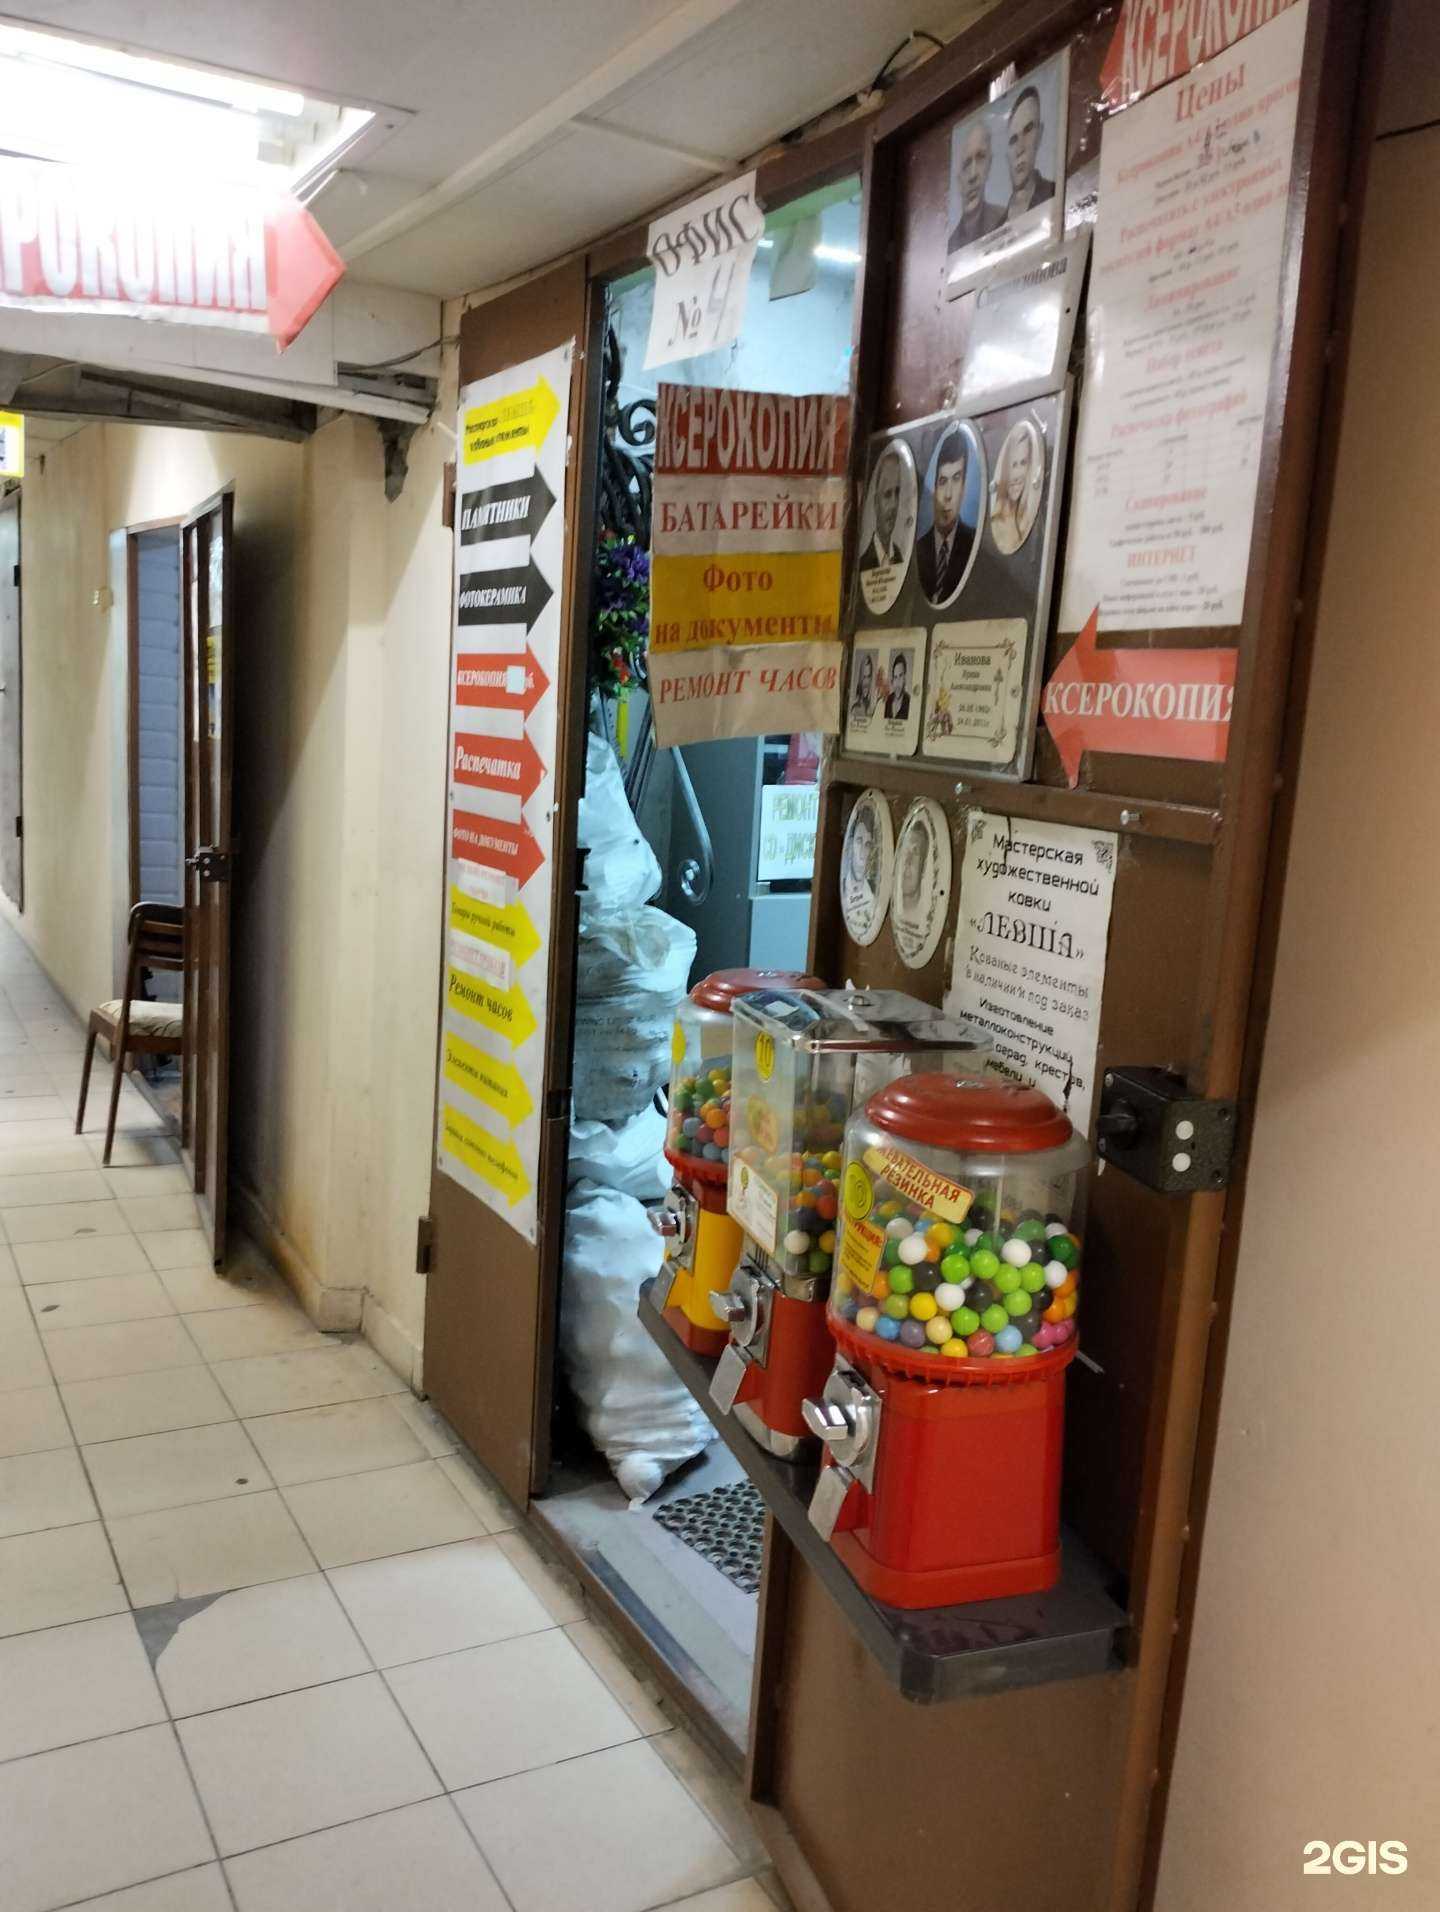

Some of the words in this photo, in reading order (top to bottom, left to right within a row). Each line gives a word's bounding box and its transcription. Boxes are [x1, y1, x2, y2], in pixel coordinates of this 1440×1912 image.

[1175, 64, 1245, 122] Цены
[652, 192, 759, 278] ОФИС
[657, 384, 838, 470] КСЕРОКОПИЯ
[660, 493, 838, 533] БАТАРЕЙКИ
[1127, 546, 1197, 569] ИНТЕРНЕТ
[459, 585, 527, 609] ФОТОКЕРАМИКА
[703, 563, 773, 593] Фото
[655, 621, 681, 645] на
[660, 669, 750, 704] РЕМОНТ
[760, 666, 837, 693] ЧАСОВ
[455, 744, 521, 781] Распечатка
[993, 834, 1084, 866] Мастерская
[976, 857, 1100, 896] художественной
[1008, 890, 1052, 912] ковки
[969, 911, 1085, 959] «ЛЕВША»
[969, 945, 1018, 975] Кованые
[1020, 966, 1090, 999] элементы
[449, 974, 484, 1007] Ремонт
[486, 997, 514, 1023] часов
[978, 997, 1055, 1036] Изготовление
[1027, 991, 1048, 1012] под
[1052, 999, 1090, 1022] заказ
[985, 1058, 1023, 1083] мебели
[1028, 1077, 1037, 1089] и
[1034, 1060, 1086, 1091] крестов,
[880, 1163, 936, 1209] РЕЗИНКА
